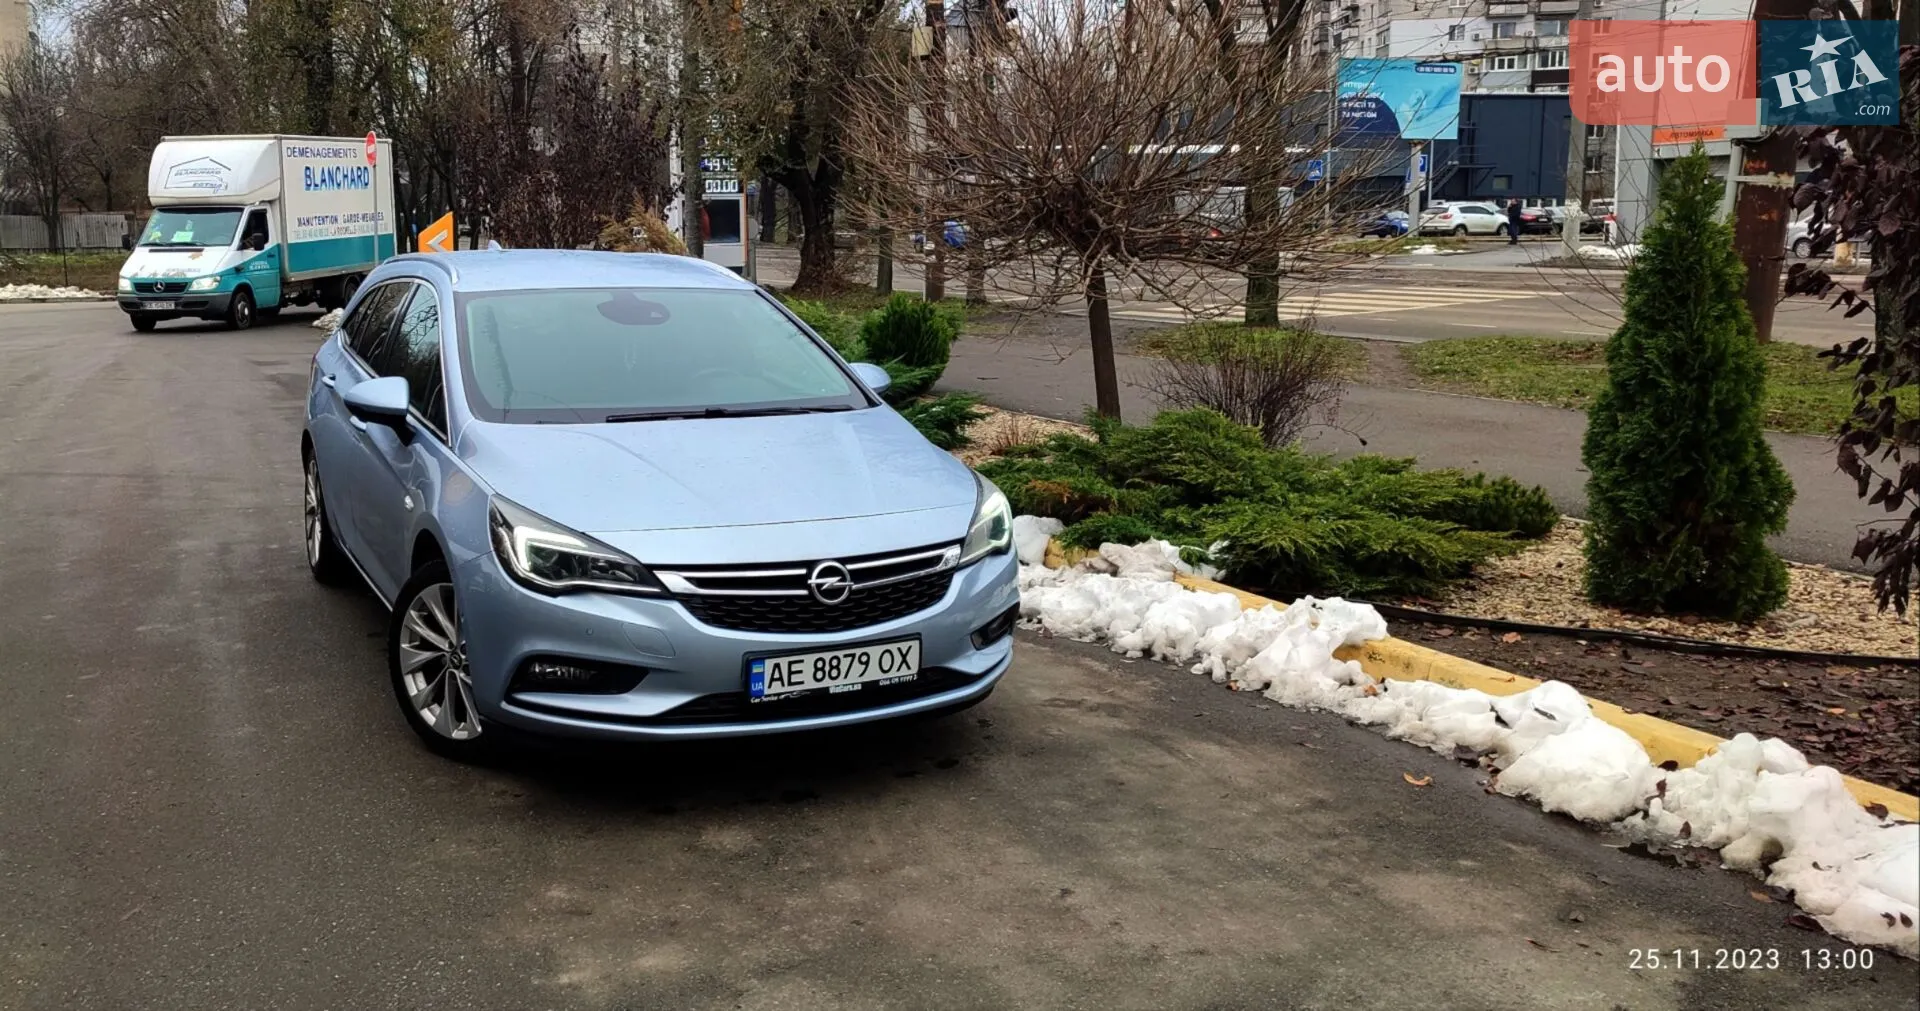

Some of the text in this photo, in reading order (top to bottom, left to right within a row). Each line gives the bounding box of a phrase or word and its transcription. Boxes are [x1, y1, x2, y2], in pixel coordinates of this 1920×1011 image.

[304, 166, 370, 191] BLANCHARD
[767, 645, 913, 689] AE 8879 OX
[752, 681, 763, 692] UA
